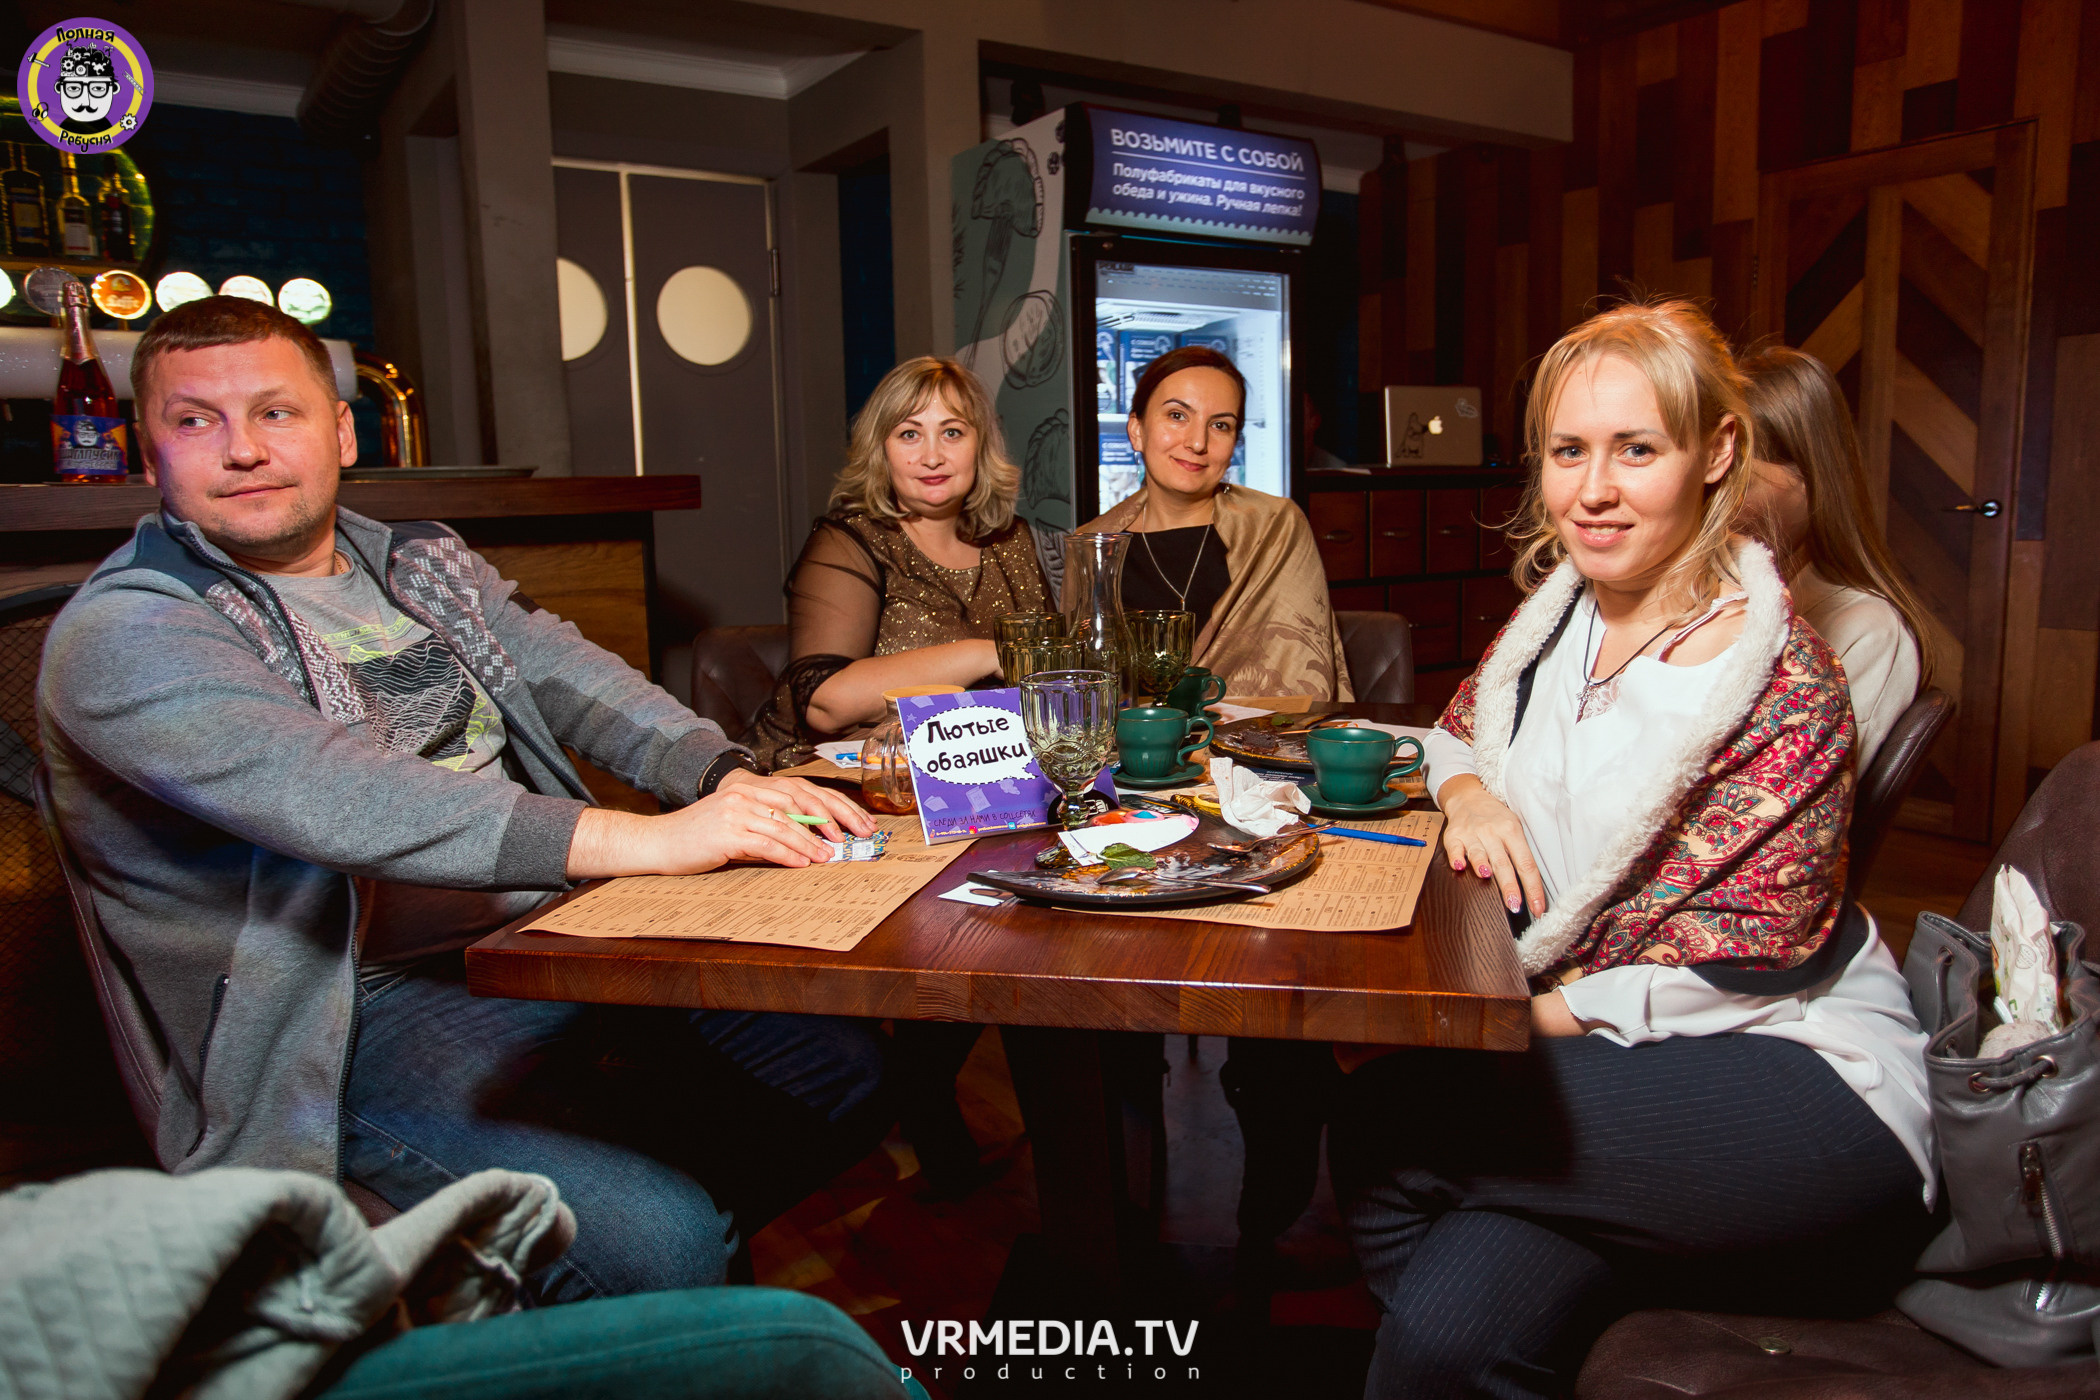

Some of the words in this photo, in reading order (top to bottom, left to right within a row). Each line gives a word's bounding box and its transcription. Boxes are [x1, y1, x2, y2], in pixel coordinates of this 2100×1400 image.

[1110, 128, 1218, 160] ВОЗЬМИТЕ
[1220, 146, 1235, 162] С
[1238, 148, 1304, 172] СОБОЙ
[1113, 162, 1222, 189] Полуфабрикаты
[1223, 180, 1248, 193] для
[1249, 182, 1305, 200] вкусного
[1113, 183, 1154, 200] обеда
[1156, 190, 1166, 200] и
[1168, 190, 1213, 206] ужина.
[1216, 196, 1261, 212] Ручная
[1262, 202, 1303, 217] лепка!
[927, 717, 1010, 743] Лютые
[926, 743, 1028, 773] обаяшки
[933, 817, 957, 827] СЛЕДИ
[959, 816, 969, 825] ЗА
[970, 813, 990, 824] НАМИ
[991, 813, 998, 821] В
